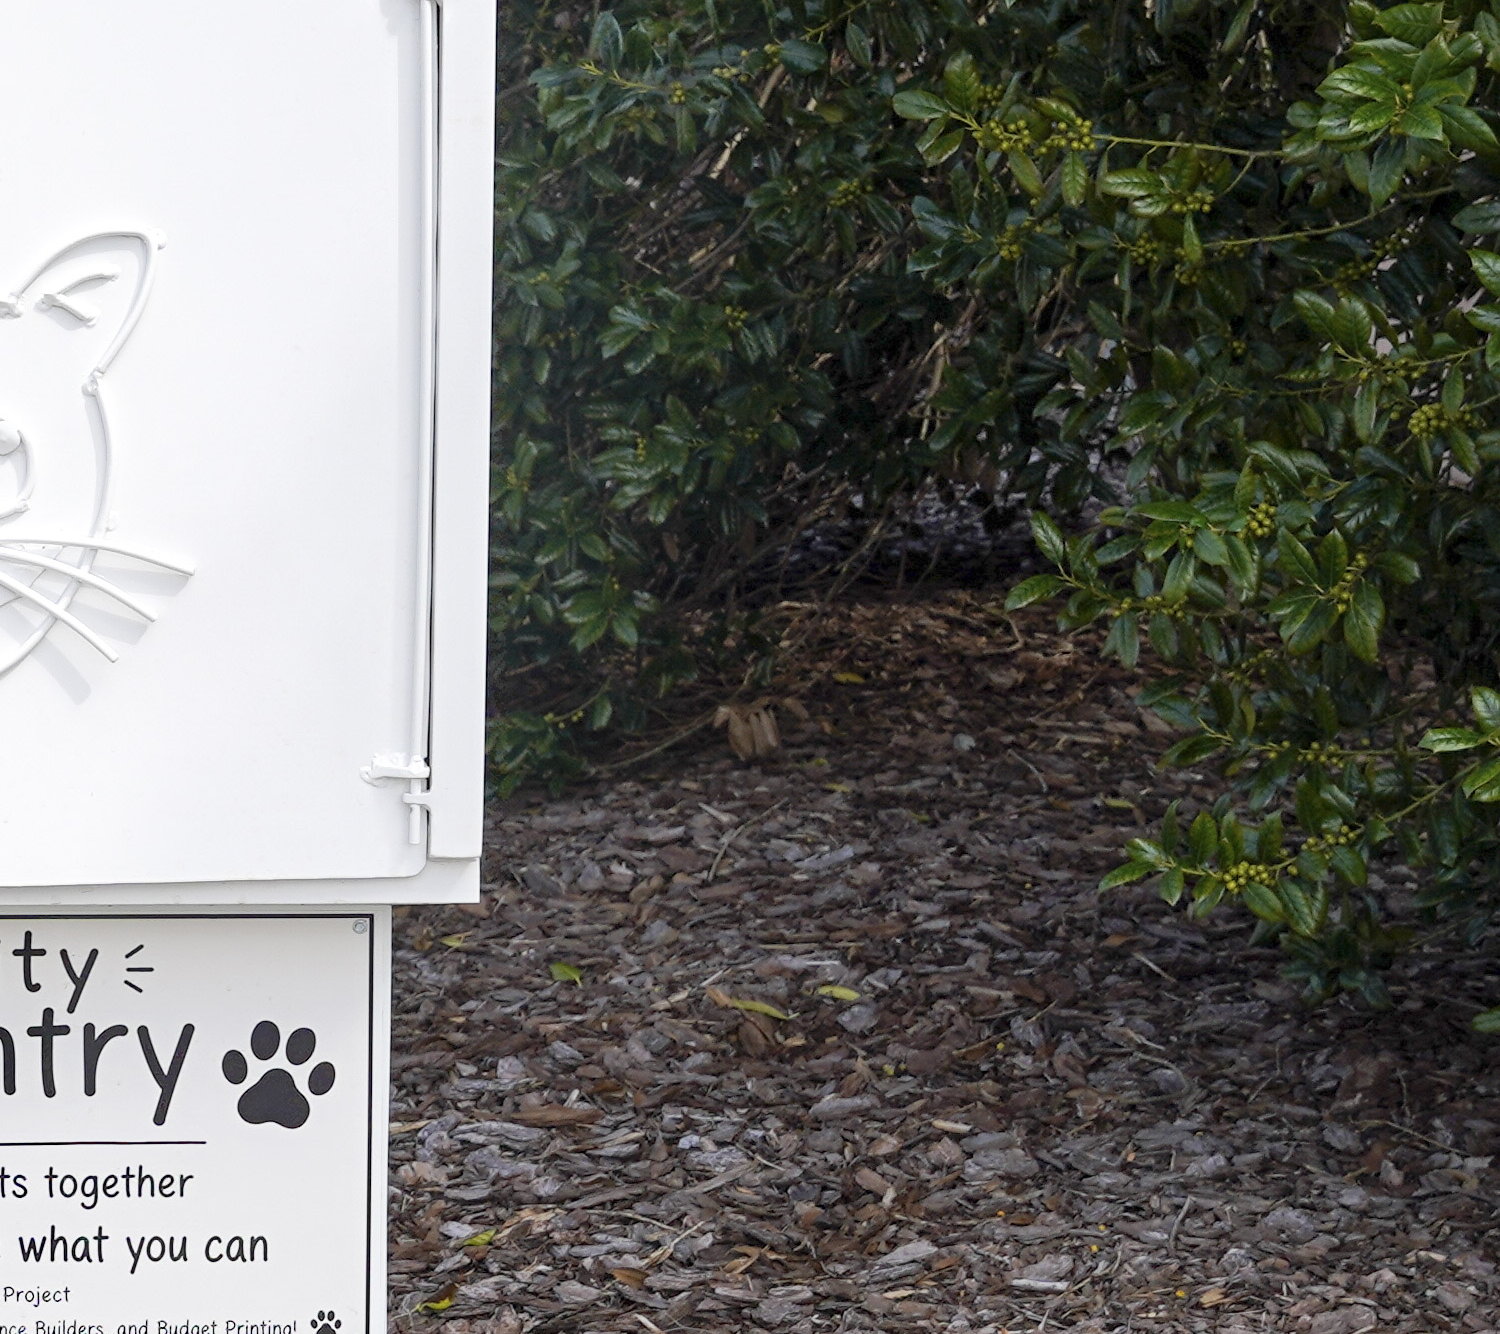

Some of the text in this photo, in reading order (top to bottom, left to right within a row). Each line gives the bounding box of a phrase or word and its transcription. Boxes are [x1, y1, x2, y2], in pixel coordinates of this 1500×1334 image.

[43, 1164, 194, 1210] together
[18, 1224, 110, 1264] what
[125, 1235, 188, 1274] you
[204, 1235, 268, 1263] can
[3, 1286, 71, 1308] Project
